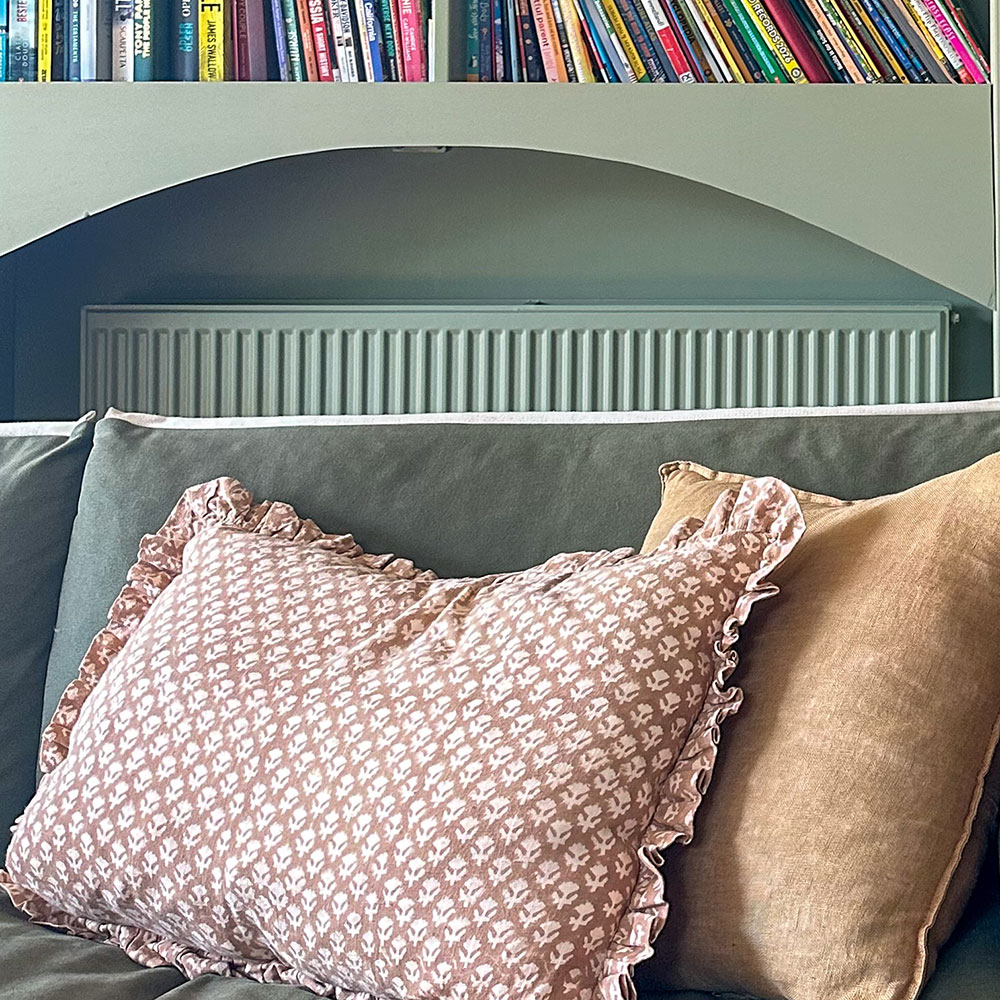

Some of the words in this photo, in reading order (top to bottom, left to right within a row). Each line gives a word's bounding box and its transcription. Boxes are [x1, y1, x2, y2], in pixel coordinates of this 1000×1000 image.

[208, 20, 217, 42] JAMES
[363, 2, 375, 42] California
[537, 19, 549, 48] parent
[753, 4, 782, 44] RECORDS
[775, 41, 794, 64] 2026
[135, 23, 143, 56] TONY
